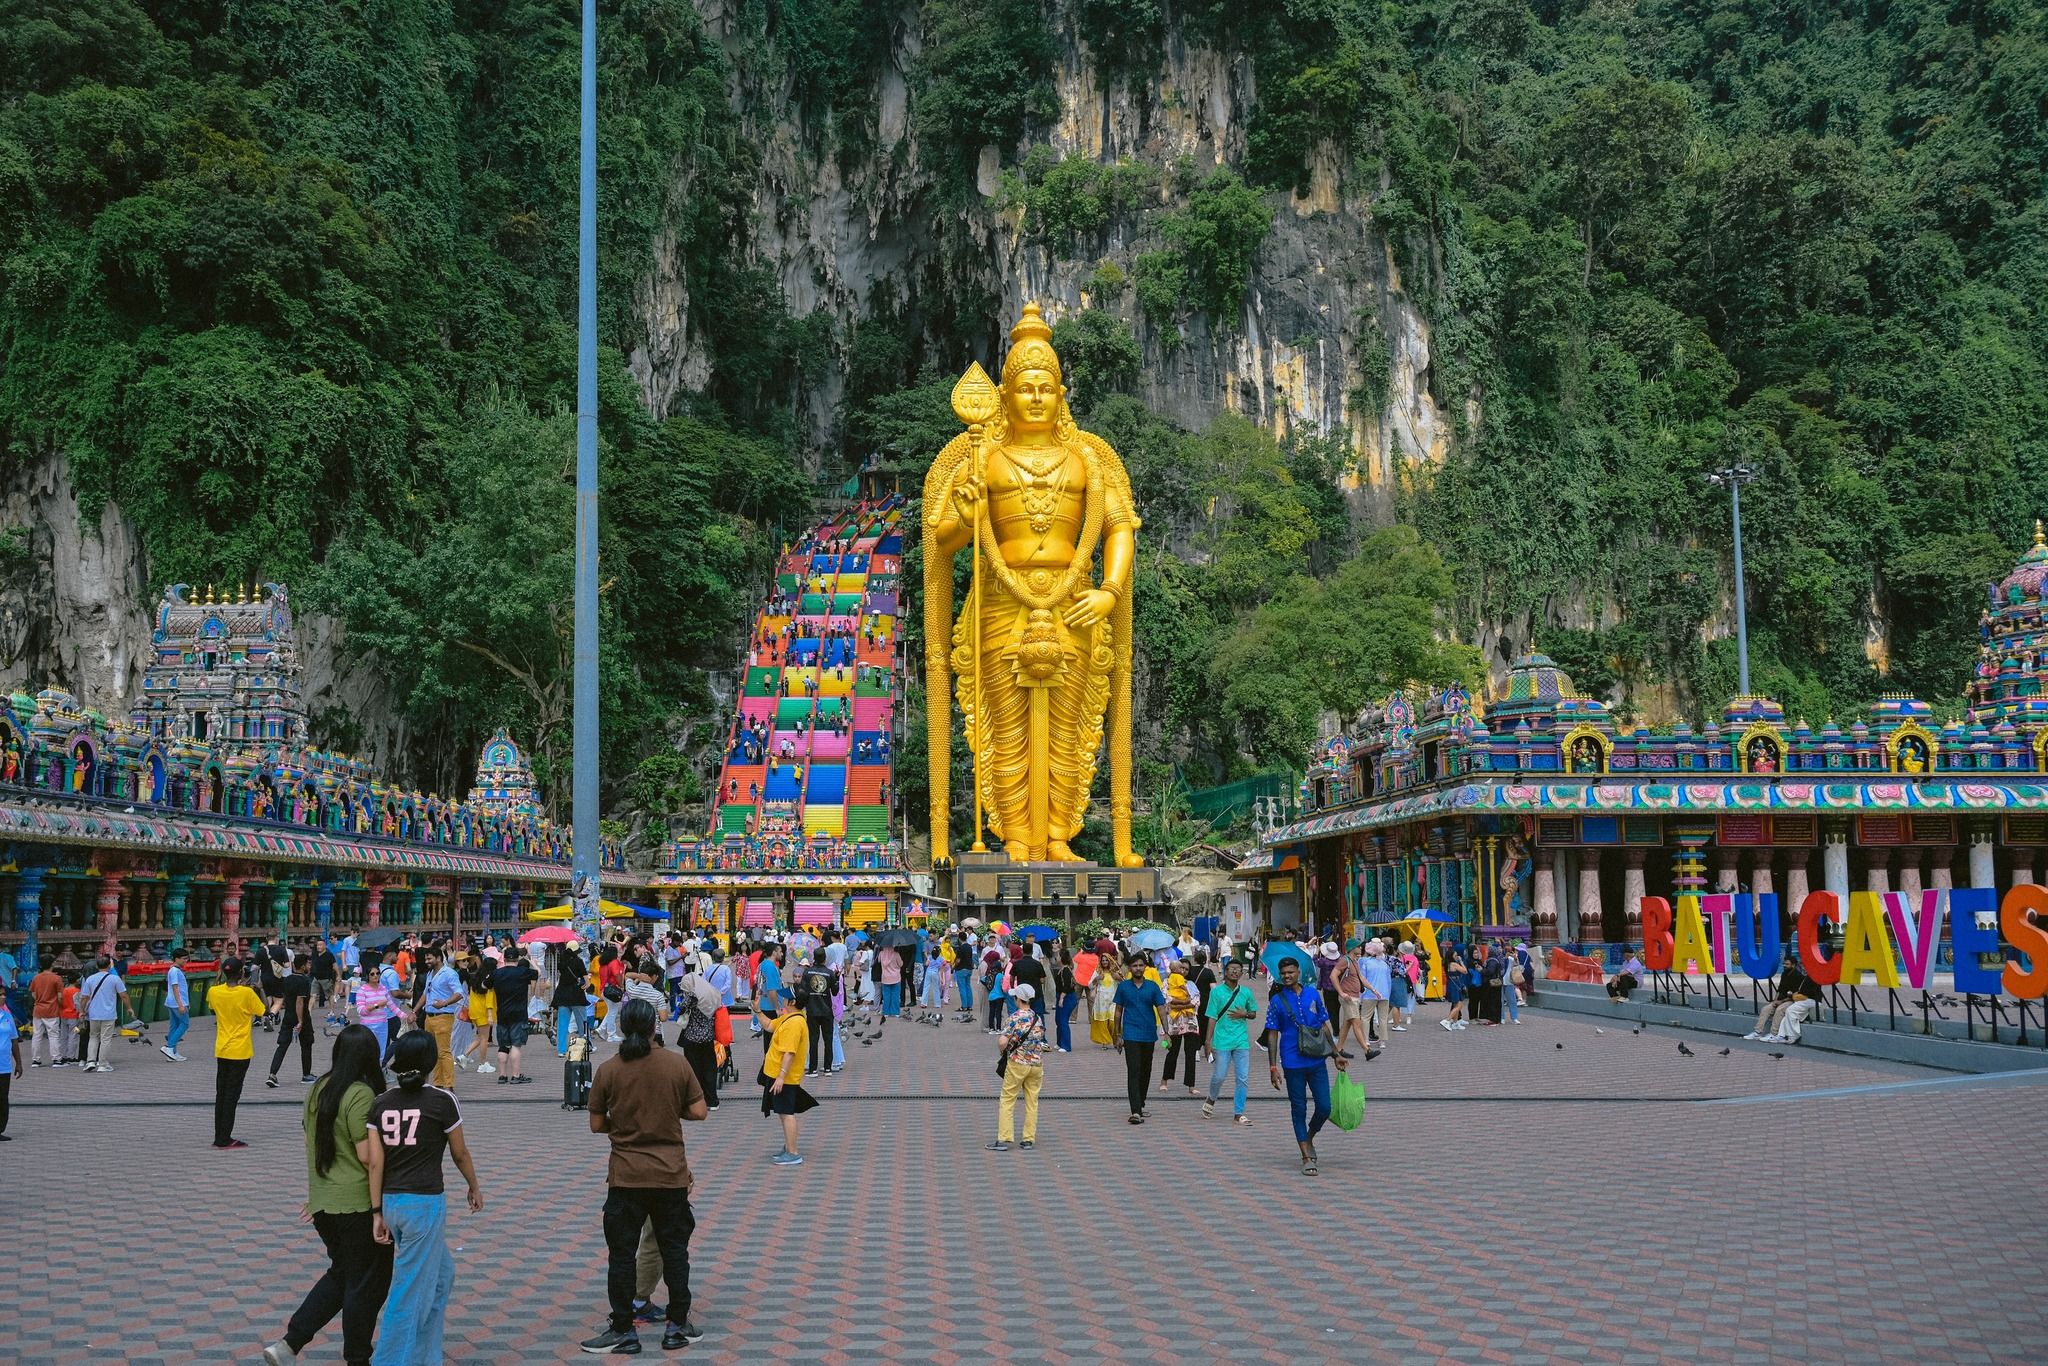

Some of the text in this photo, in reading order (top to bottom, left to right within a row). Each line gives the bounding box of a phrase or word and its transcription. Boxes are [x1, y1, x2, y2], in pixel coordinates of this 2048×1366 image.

[1640, 884, 2048, 999] BATU CAVES
[381, 1109, 421, 1146] 97
